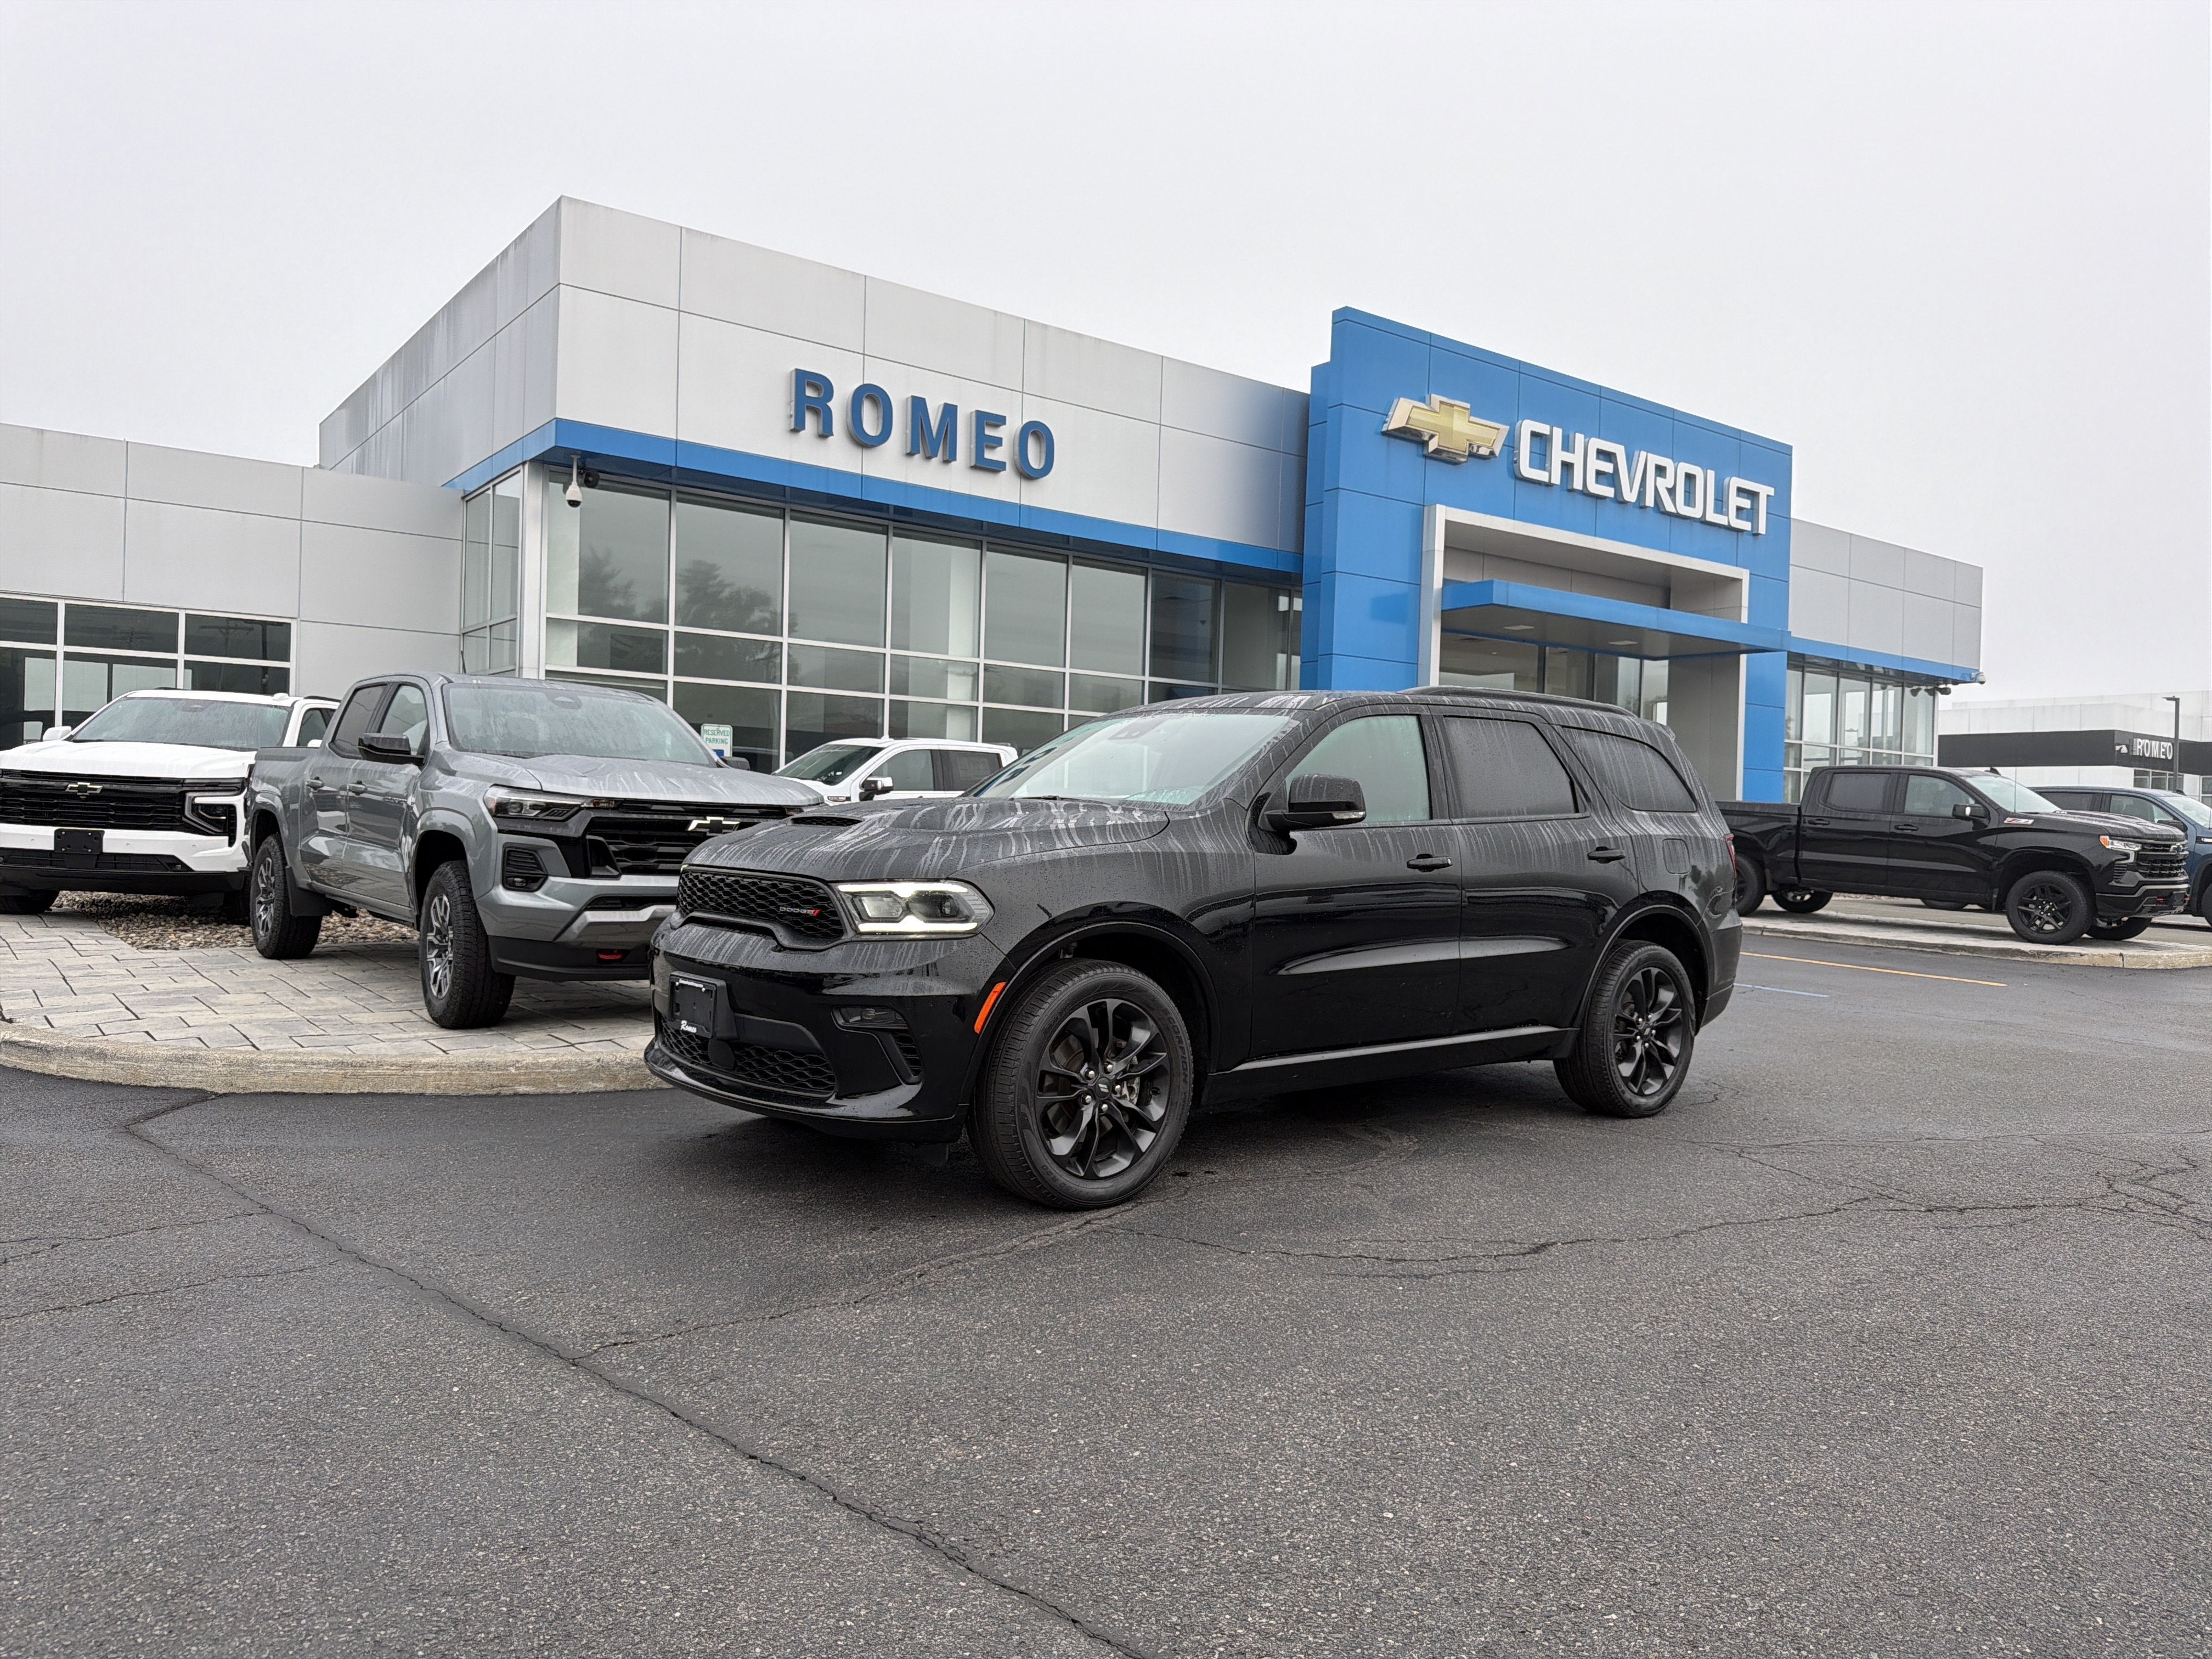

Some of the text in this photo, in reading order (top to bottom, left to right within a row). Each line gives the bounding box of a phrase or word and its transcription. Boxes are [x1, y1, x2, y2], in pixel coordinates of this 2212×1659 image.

[791, 368, 1054, 479] ROMEO
[1514, 419, 1774, 535] CHEVROLET
[2135, 738, 2173, 760] ROMEO
[779, 906, 814, 915] DODGE
